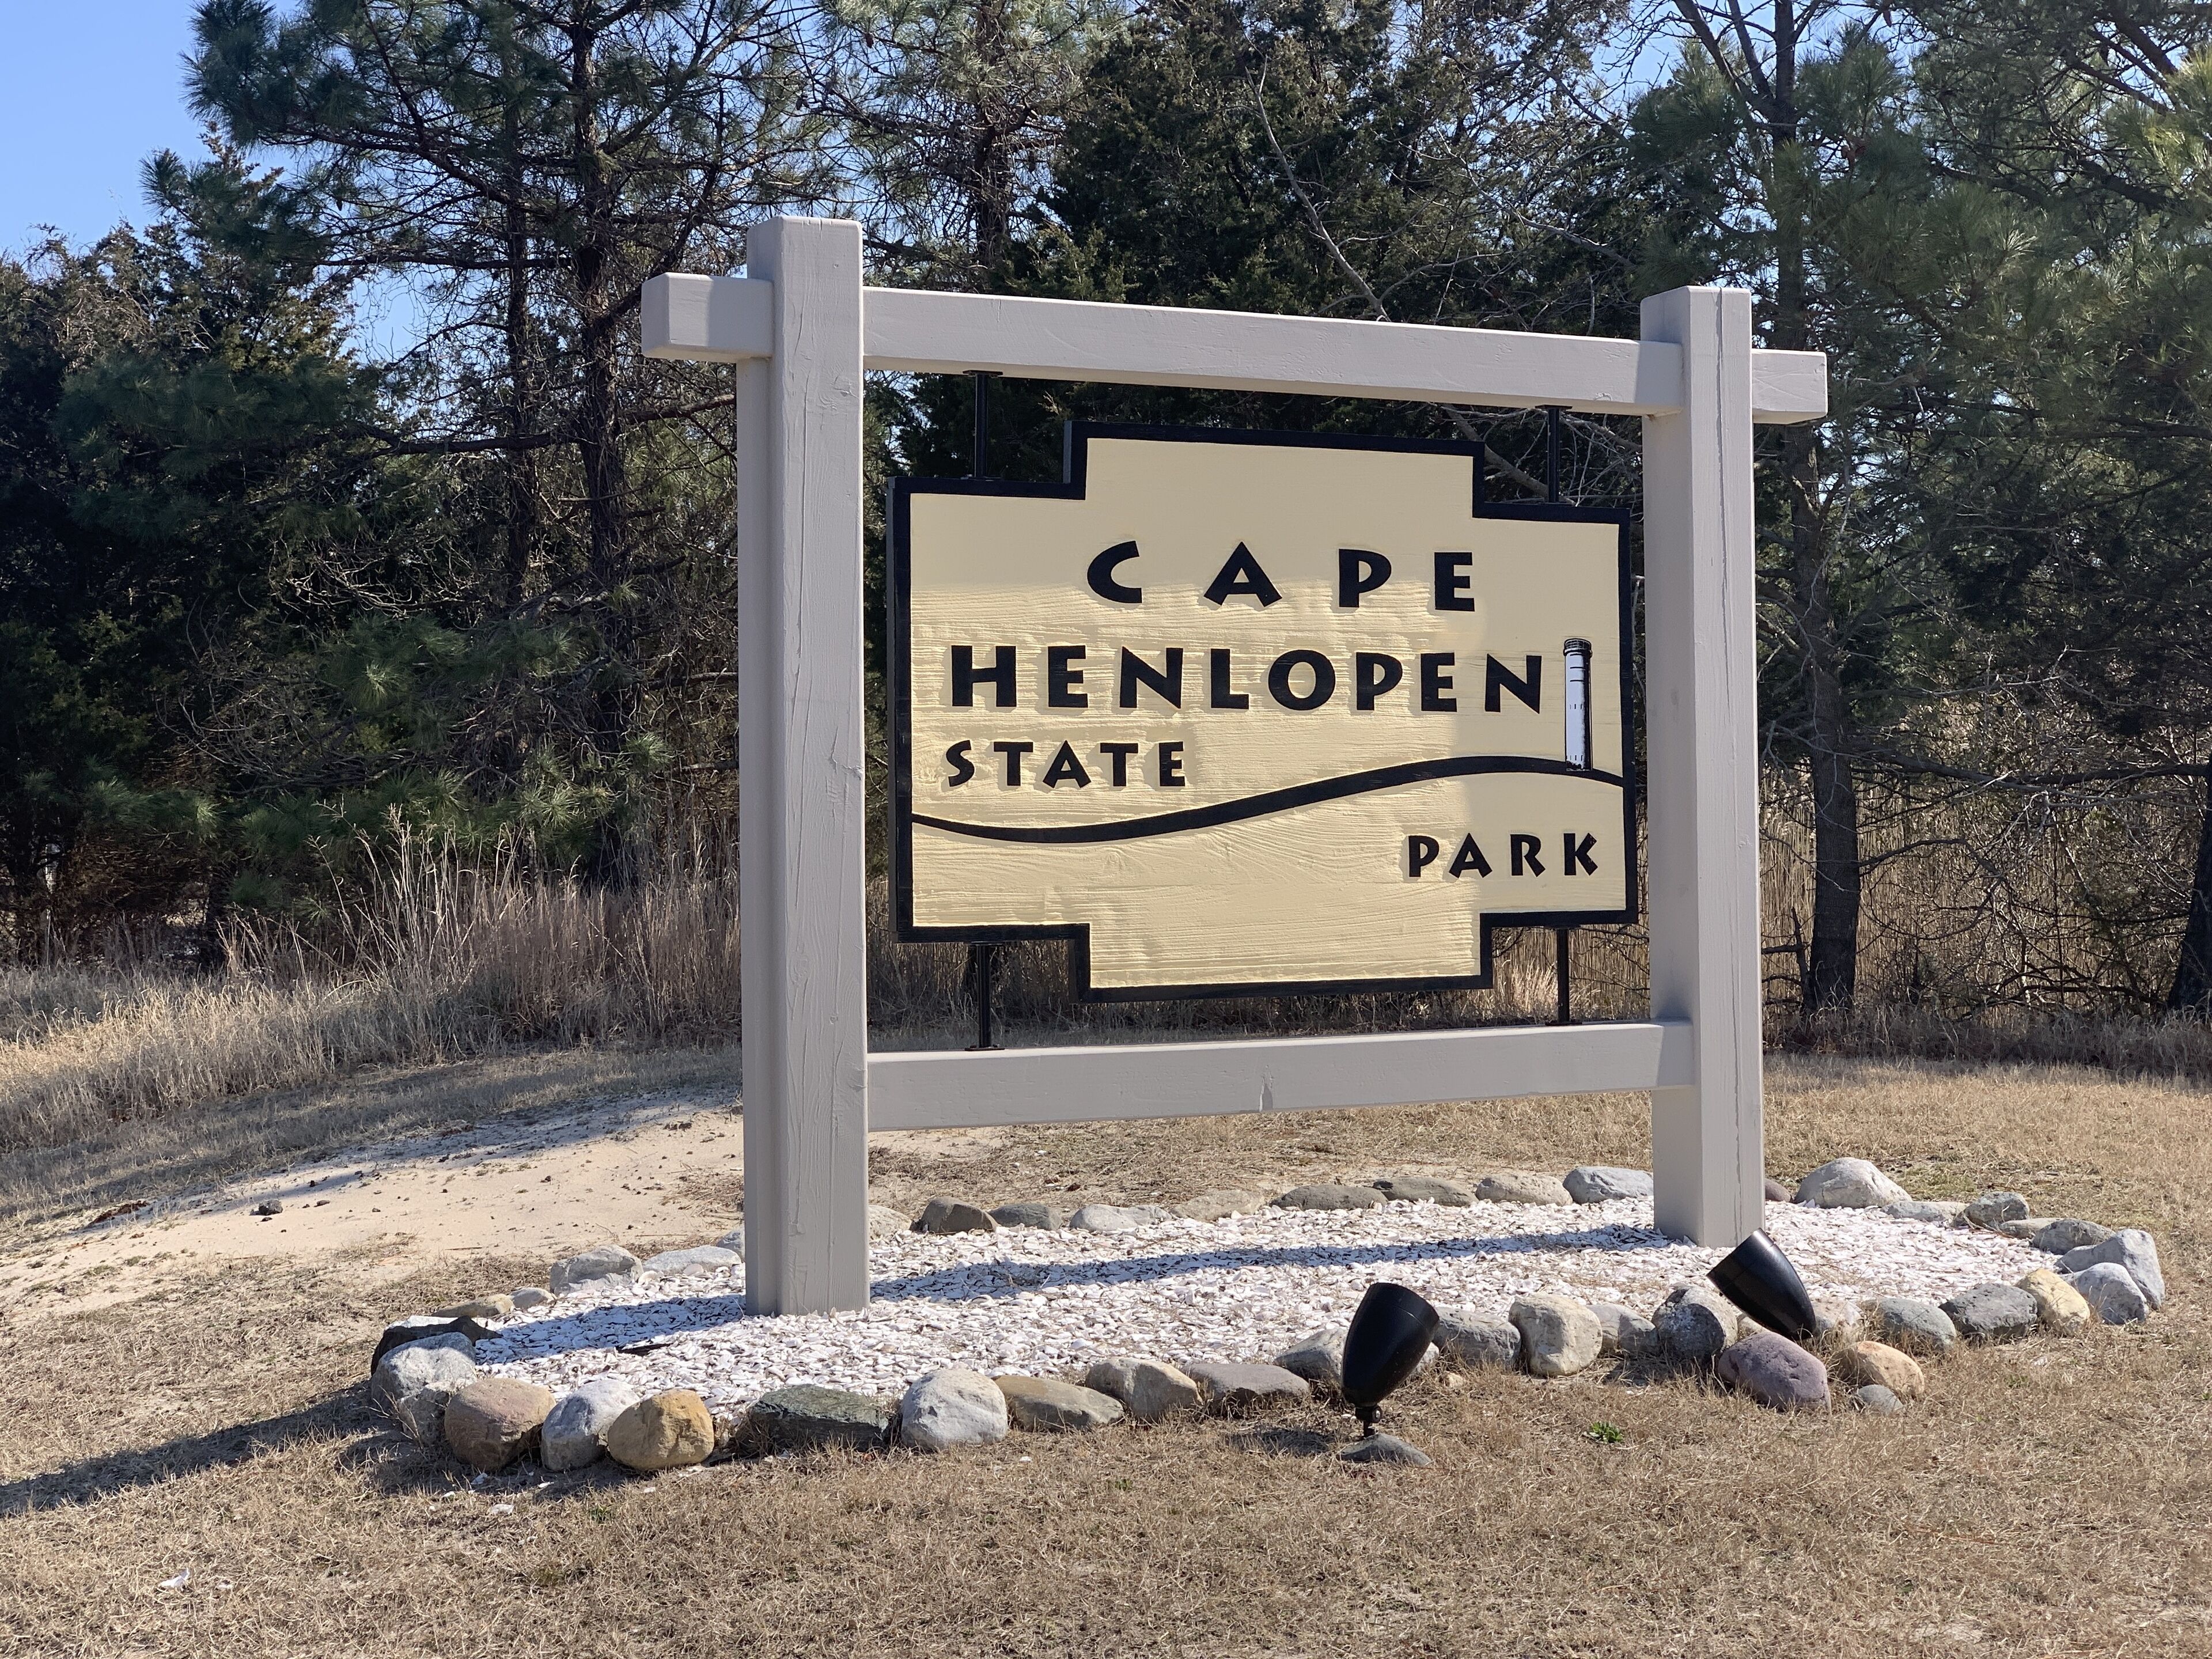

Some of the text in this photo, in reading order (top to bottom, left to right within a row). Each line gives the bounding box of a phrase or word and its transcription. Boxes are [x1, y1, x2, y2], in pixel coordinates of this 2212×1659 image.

[1086, 540, 1476, 612] CAPE
[951, 644, 1542, 714] HENLOPEN
[945, 740, 1185, 789] STATE
[1408, 832, 1599, 879] PARK
